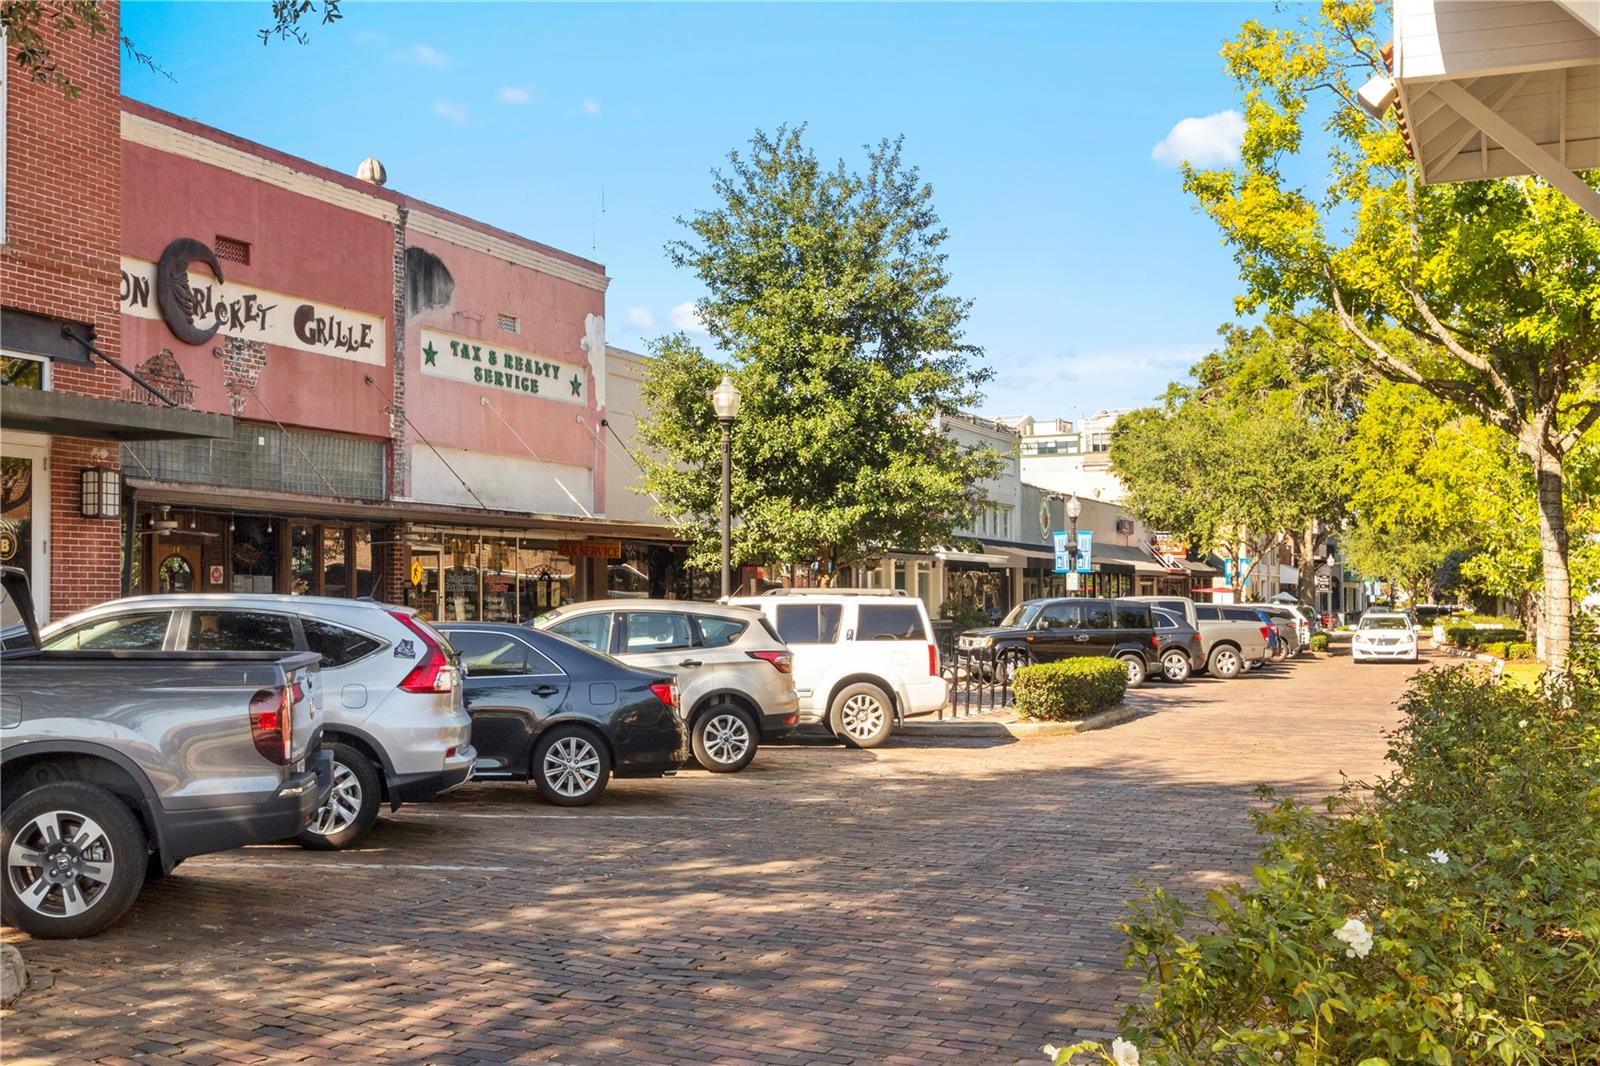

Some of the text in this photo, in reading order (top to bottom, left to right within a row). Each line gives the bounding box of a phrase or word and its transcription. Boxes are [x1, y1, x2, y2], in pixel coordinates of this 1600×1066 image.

[293, 304, 374, 353] GRILLE
[450, 340, 561, 380] TAX & REALTY
[473, 366, 540, 394] SERVICE
[579, 543, 620, 558] SERVICE
